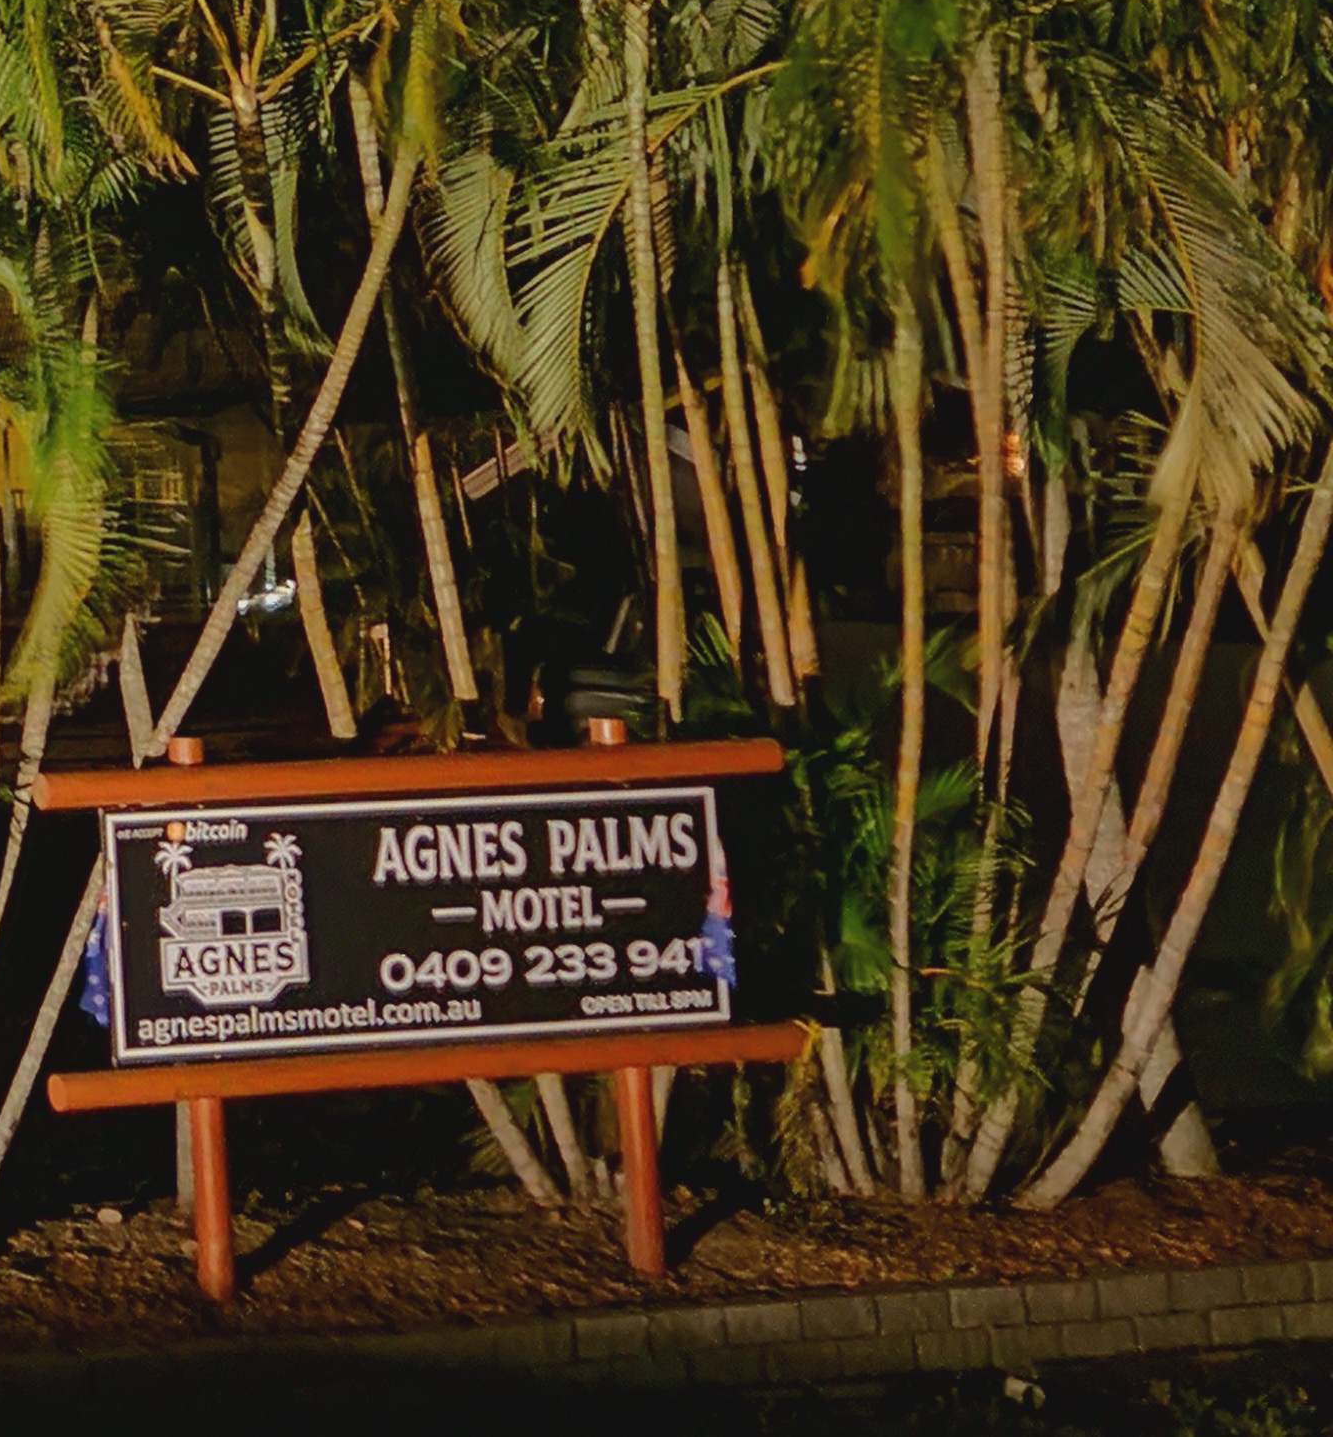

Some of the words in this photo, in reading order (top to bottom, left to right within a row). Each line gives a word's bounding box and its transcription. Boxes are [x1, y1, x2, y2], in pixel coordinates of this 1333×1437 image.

[185, 819, 248, 841] bitcoin
[372, 821, 527, 883] AGNES
[546, 813, 698, 874] PALMS
[480, 885, 603, 932] MOTEL
[173, 942, 294, 978] AGNES
[380, 947, 513, 991] 0409
[524, 942, 618, 983] 233
[626, 937, 704, 978] 941
[209, 978, 264, 995] PALMS
[137, 998, 482, 1045] agnespalmsmotel.com.au
